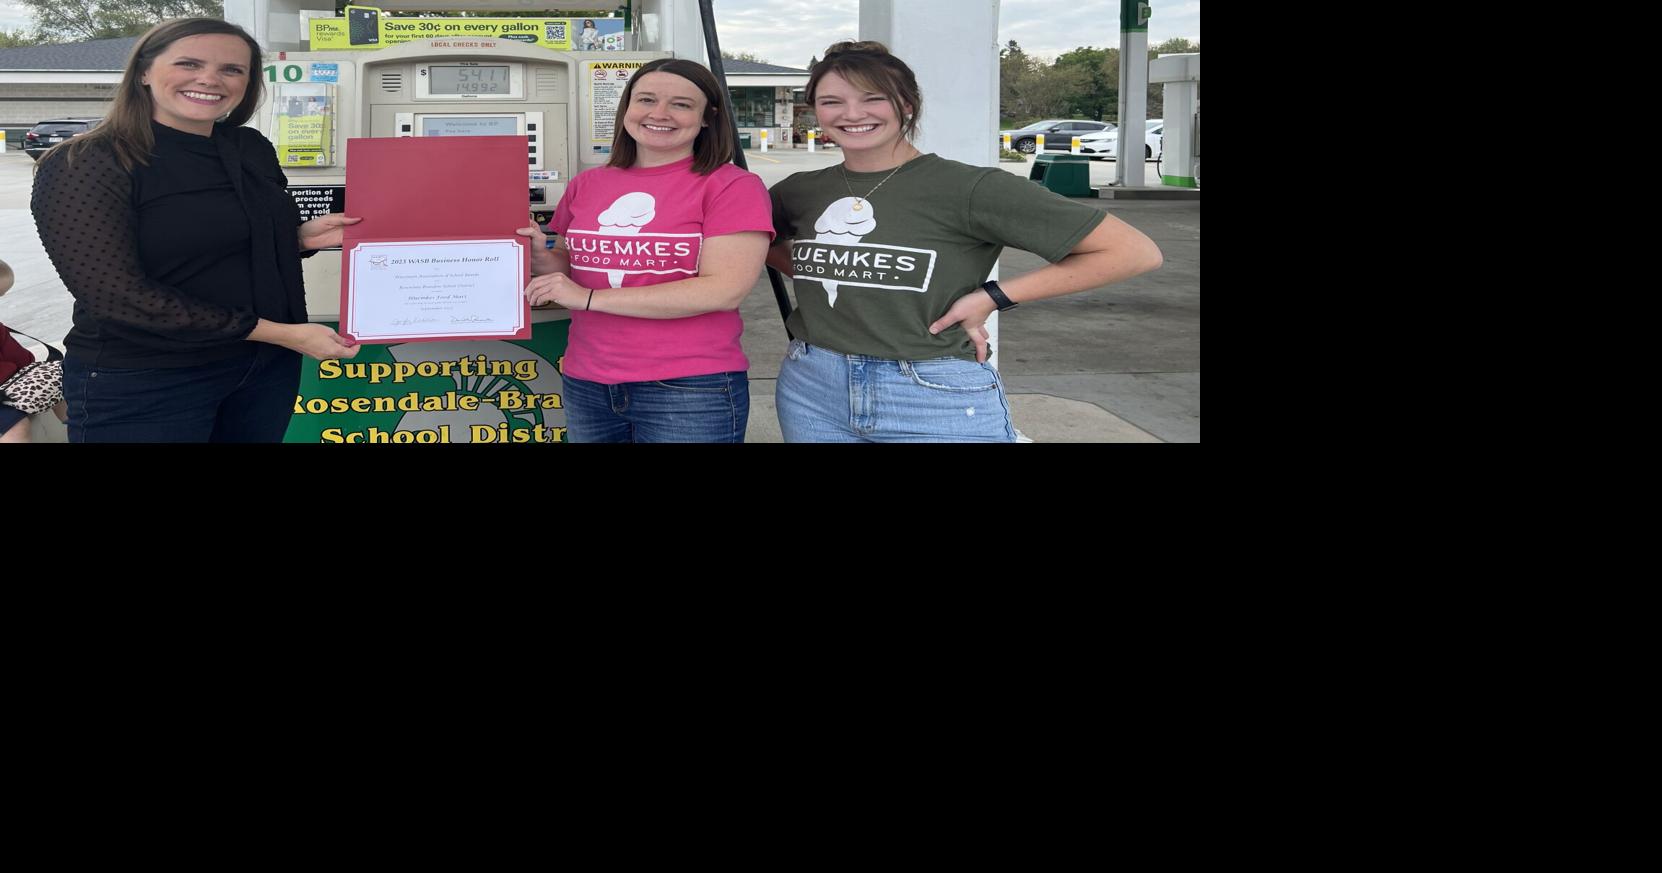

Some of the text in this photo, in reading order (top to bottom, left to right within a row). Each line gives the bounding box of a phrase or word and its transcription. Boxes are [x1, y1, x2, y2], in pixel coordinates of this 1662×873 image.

[384, 22, 416, 31] Save
[419, 22, 441, 32] 30¢
[464, 24, 498, 33] every
[501, 22, 539, 32] gallon
[263, 64, 303, 83] 10
[420, 68, 427, 76] $
[291, 188, 322, 197] portion
[324, 188, 333, 196] of
[295, 195, 334, 203] proceeds
[574, 254, 667, 268] FOOD MART
[792, 246, 916, 272] LUEMKES
[834, 268, 887, 281] MART
[318, 353, 538, 384] Supporting
[293, 390, 564, 414] Rosendale-Bra
[320, 421, 568, 443] School Distr
